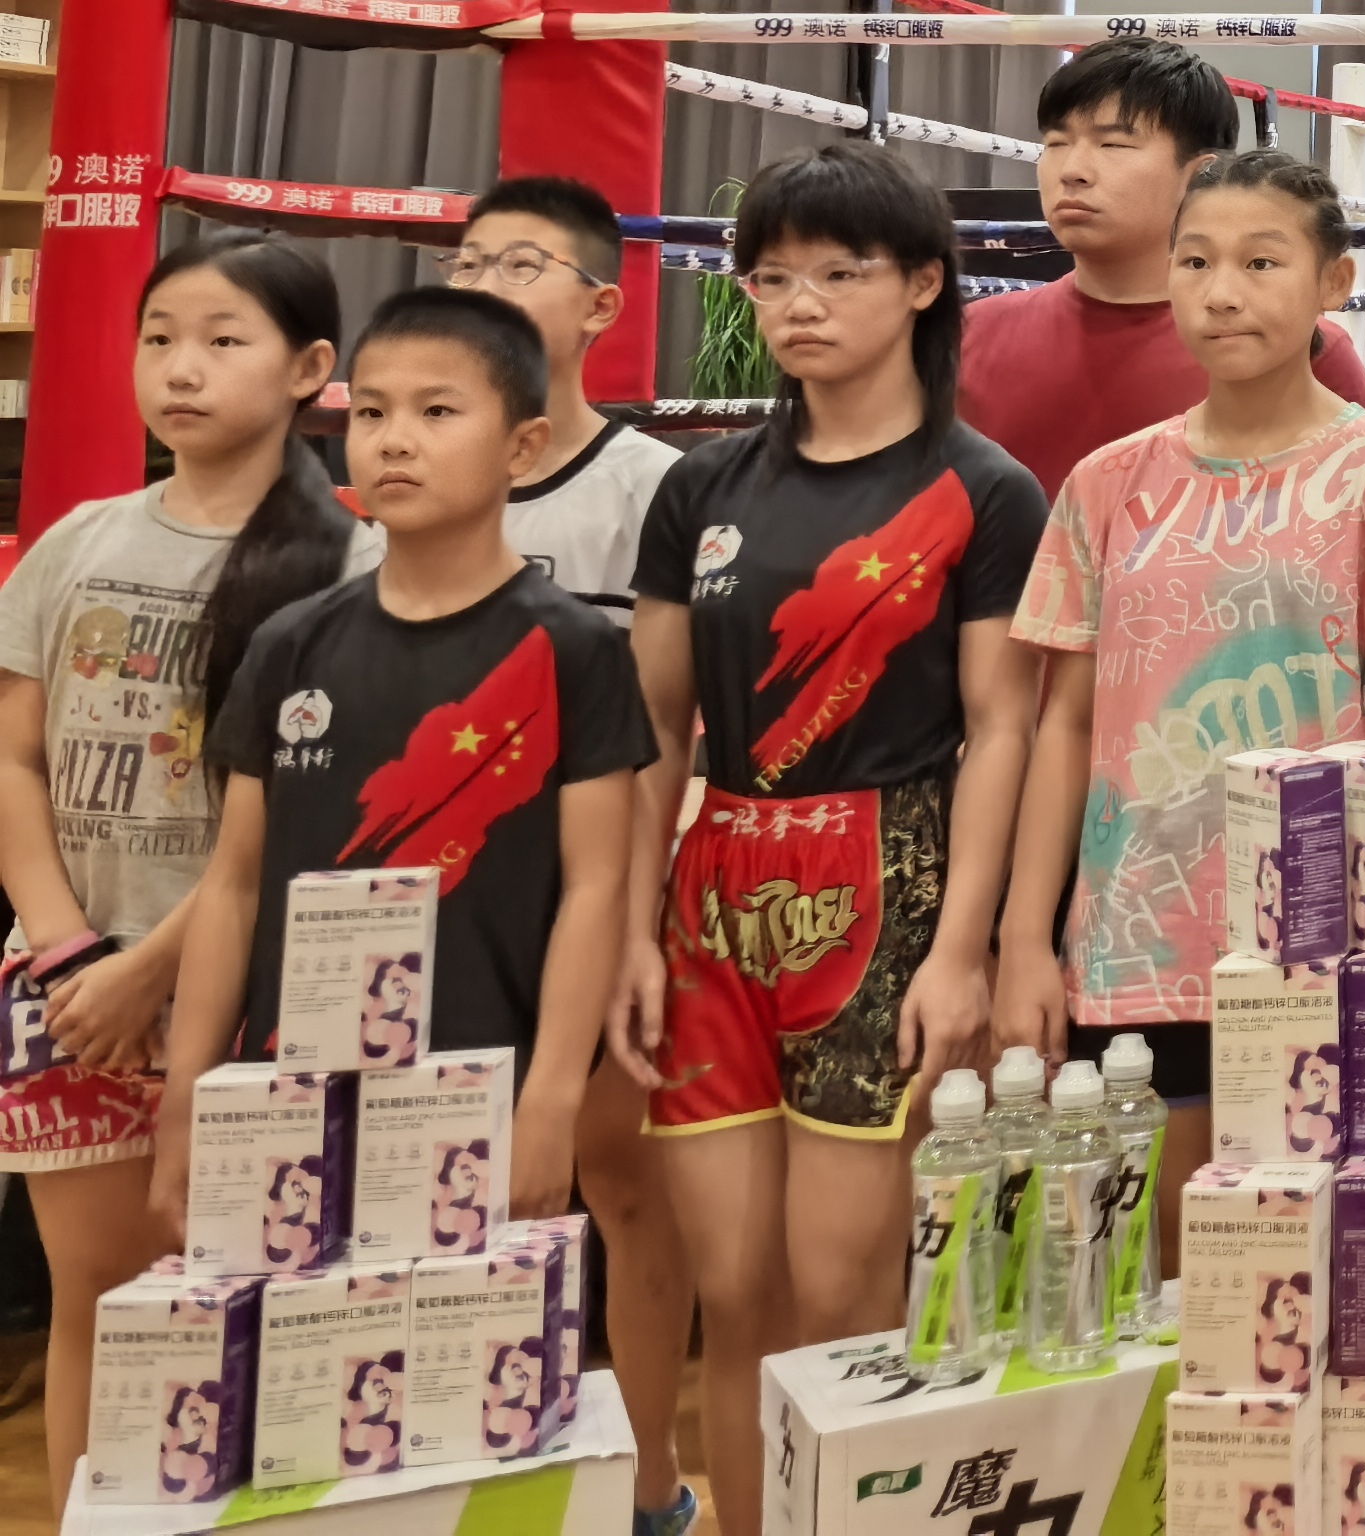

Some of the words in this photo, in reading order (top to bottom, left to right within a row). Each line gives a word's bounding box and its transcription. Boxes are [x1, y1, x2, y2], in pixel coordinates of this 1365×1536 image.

[755, 18, 793, 37] 999
[804, 18, 847, 38] 澳诺
[1107, 18, 1146, 38] 999
[1156, 18, 1200, 38] 澳诺
[1215, 17, 1297, 37] 钙锌口服液
[75, 154, 145, 185] 澳诺
[226, 182, 273, 205] 999
